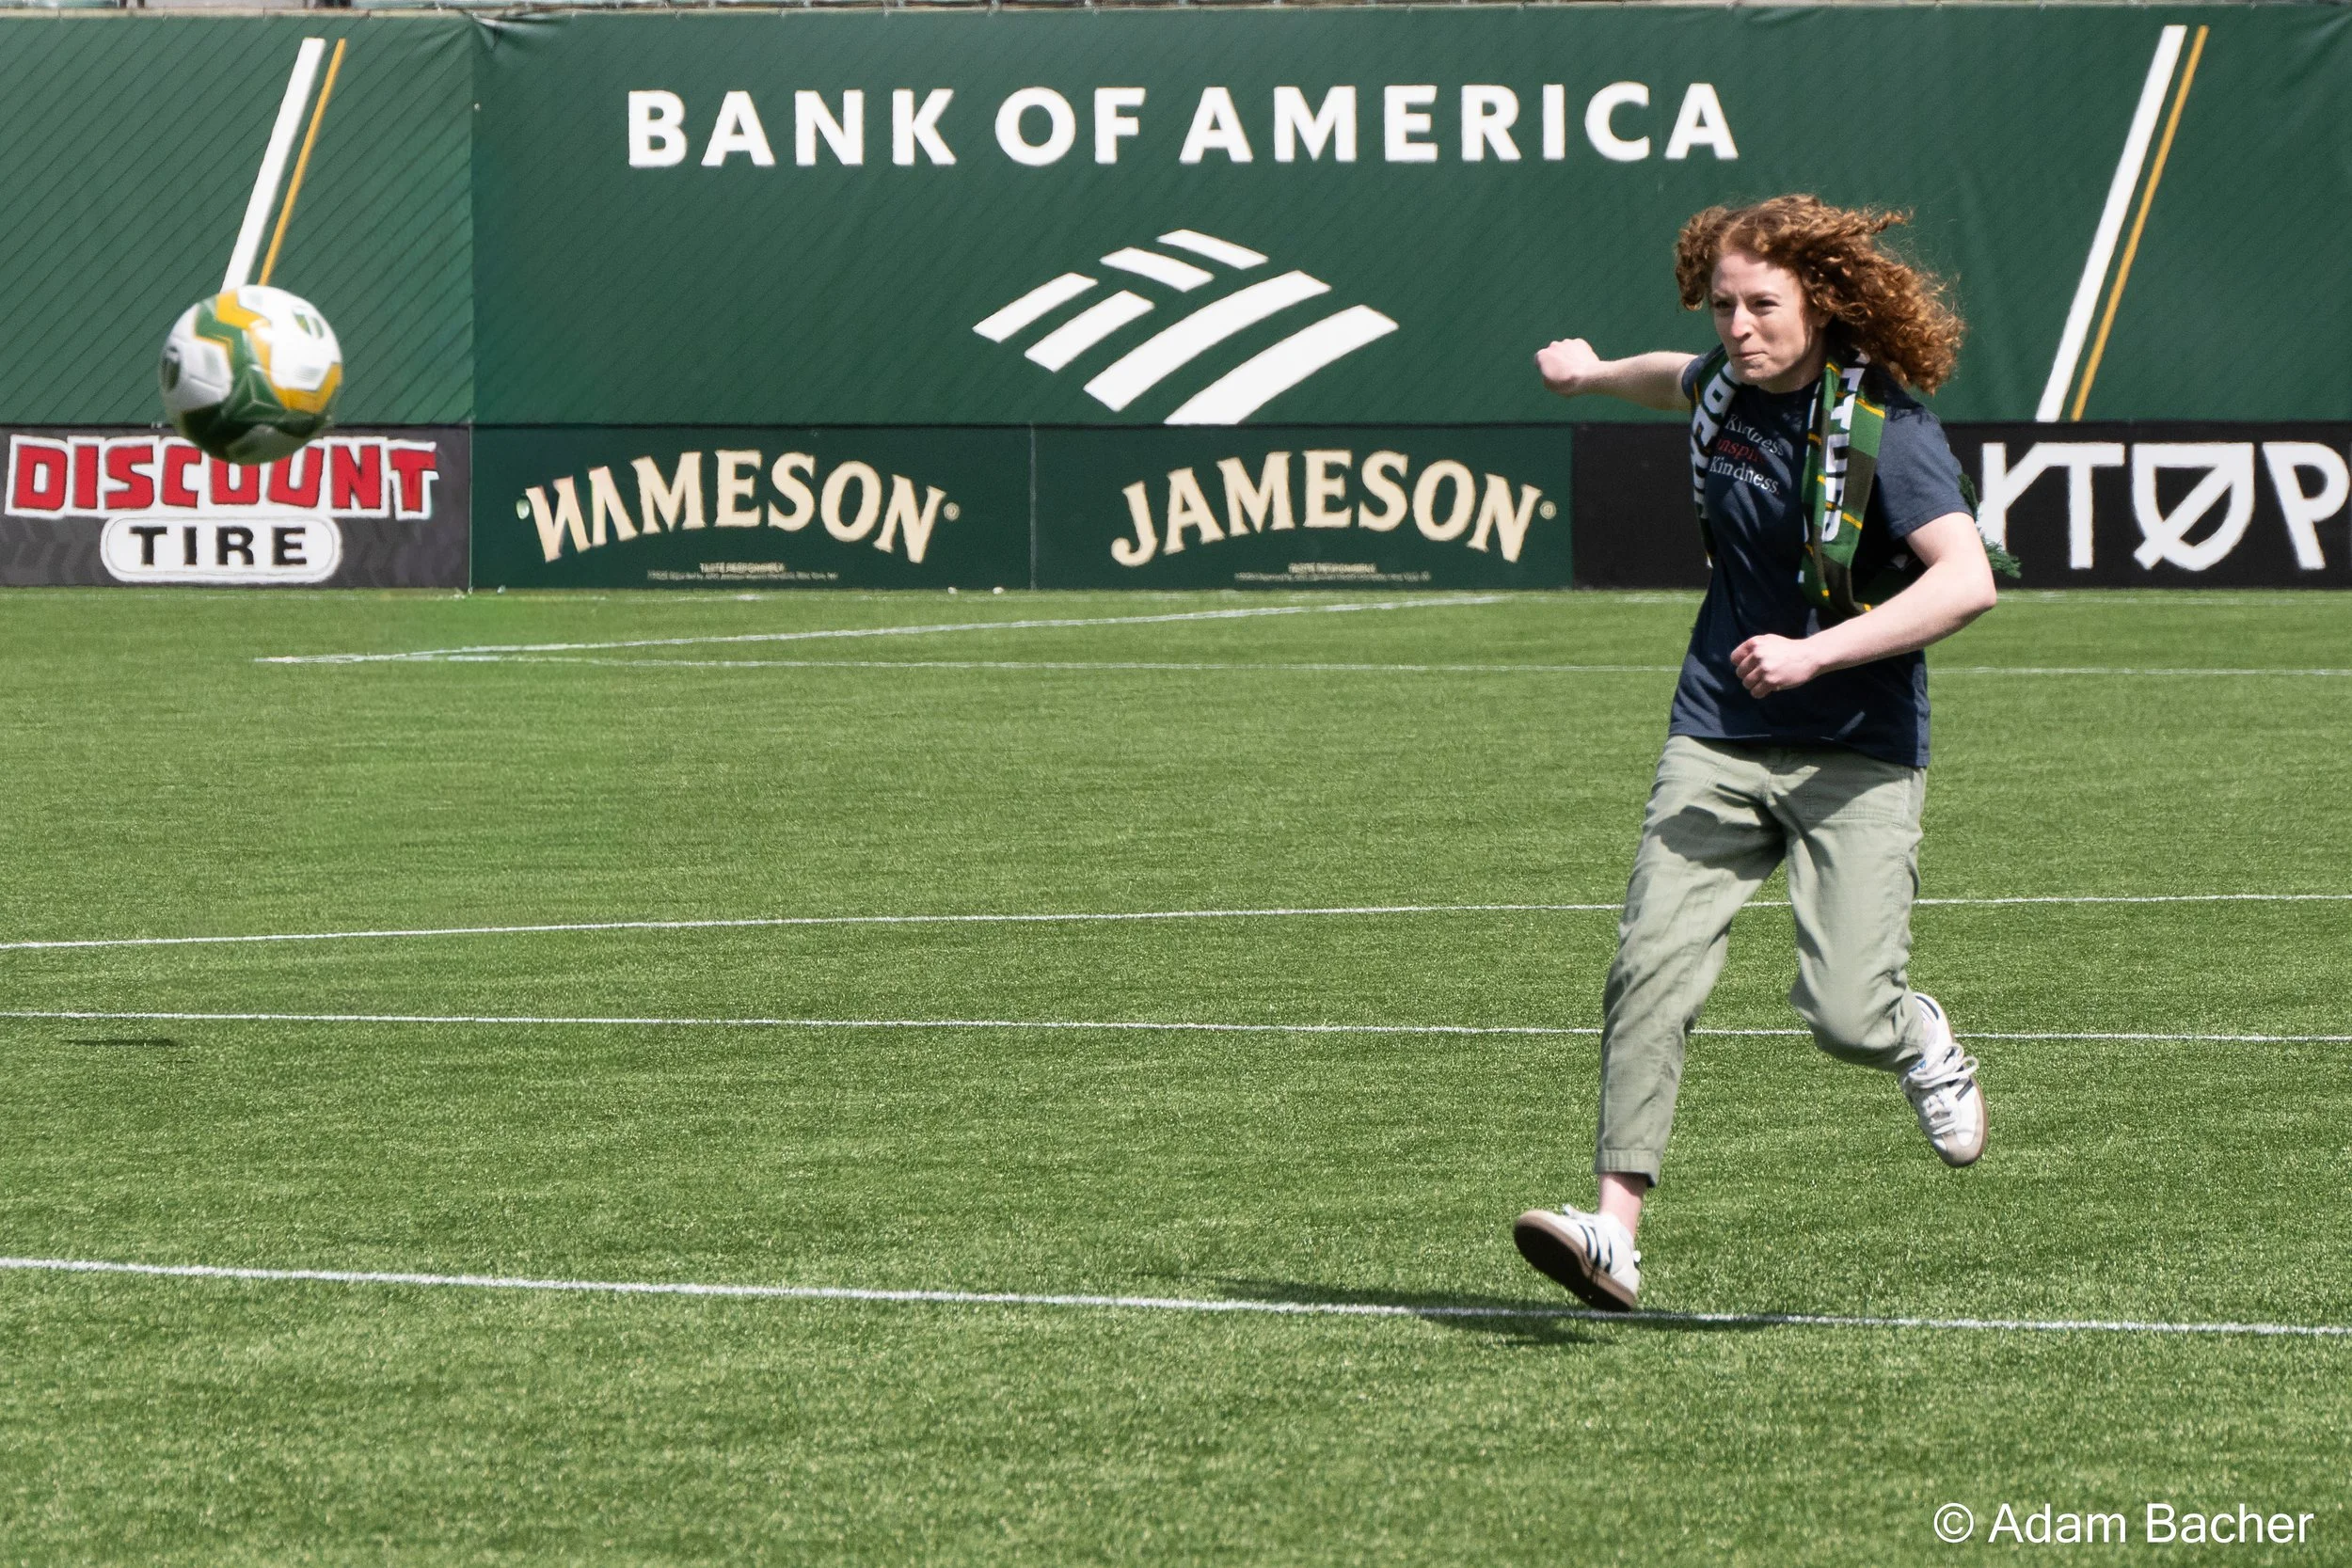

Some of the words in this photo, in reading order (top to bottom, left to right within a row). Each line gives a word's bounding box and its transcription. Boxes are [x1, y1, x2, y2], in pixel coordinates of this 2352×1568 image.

[628, 88, 957, 167] BANK
[994, 87, 1147, 166] OF
[1179, 81, 1740, 164] AMERICA
[7, 437, 439, 518] DISCOUNT
[1110, 449, 1543, 567] JAMESON
[130, 526, 308, 566] TIRE
